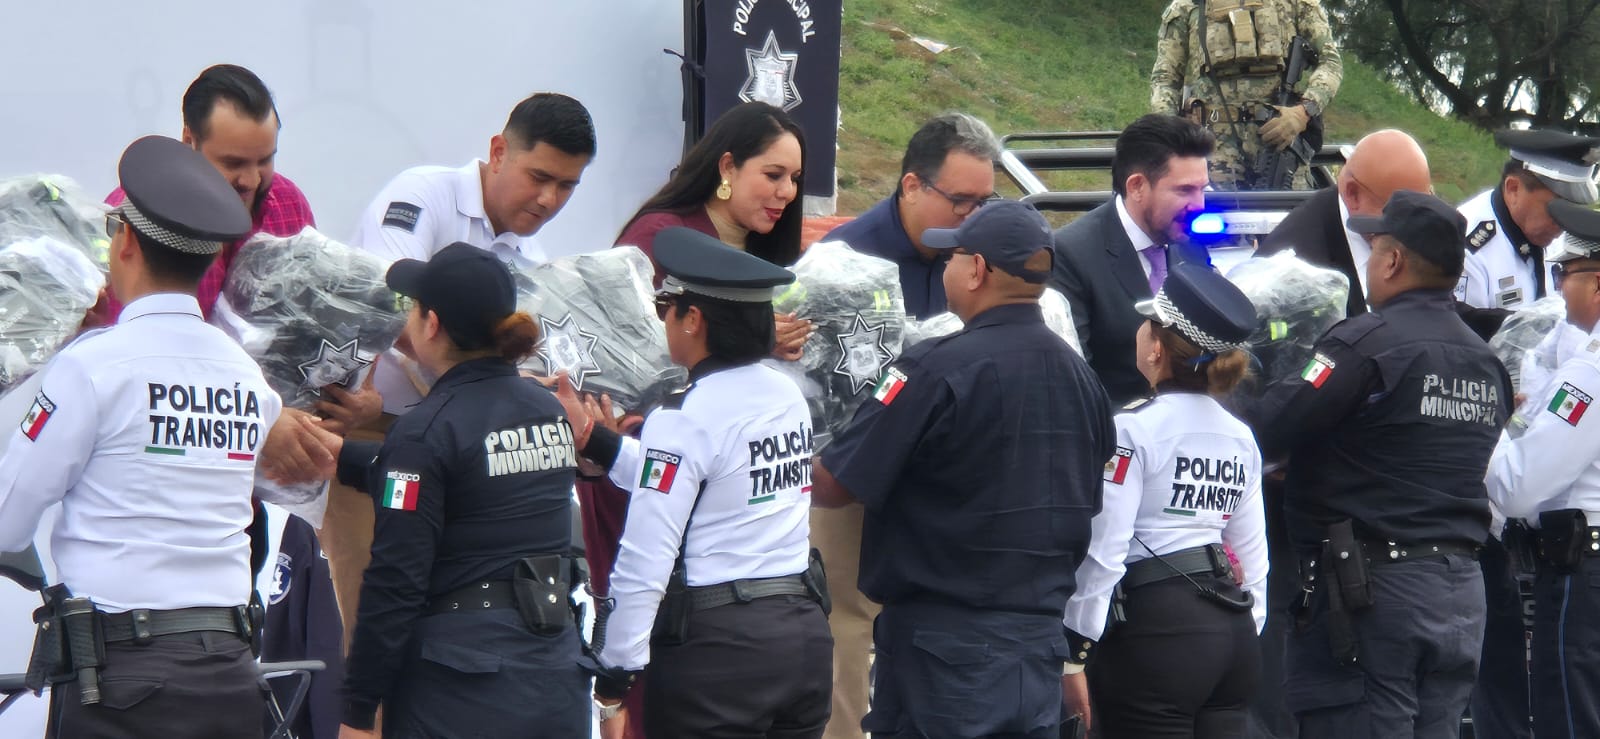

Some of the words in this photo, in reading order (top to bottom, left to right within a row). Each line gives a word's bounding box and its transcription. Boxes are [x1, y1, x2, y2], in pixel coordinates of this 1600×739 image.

[148, 382, 260, 418] POLICÍA
[149, 415, 259, 451] TRANSITO
[1175, 455, 1246, 487] POLICÍA
[1169, 483, 1244, 513] TRANSITO
